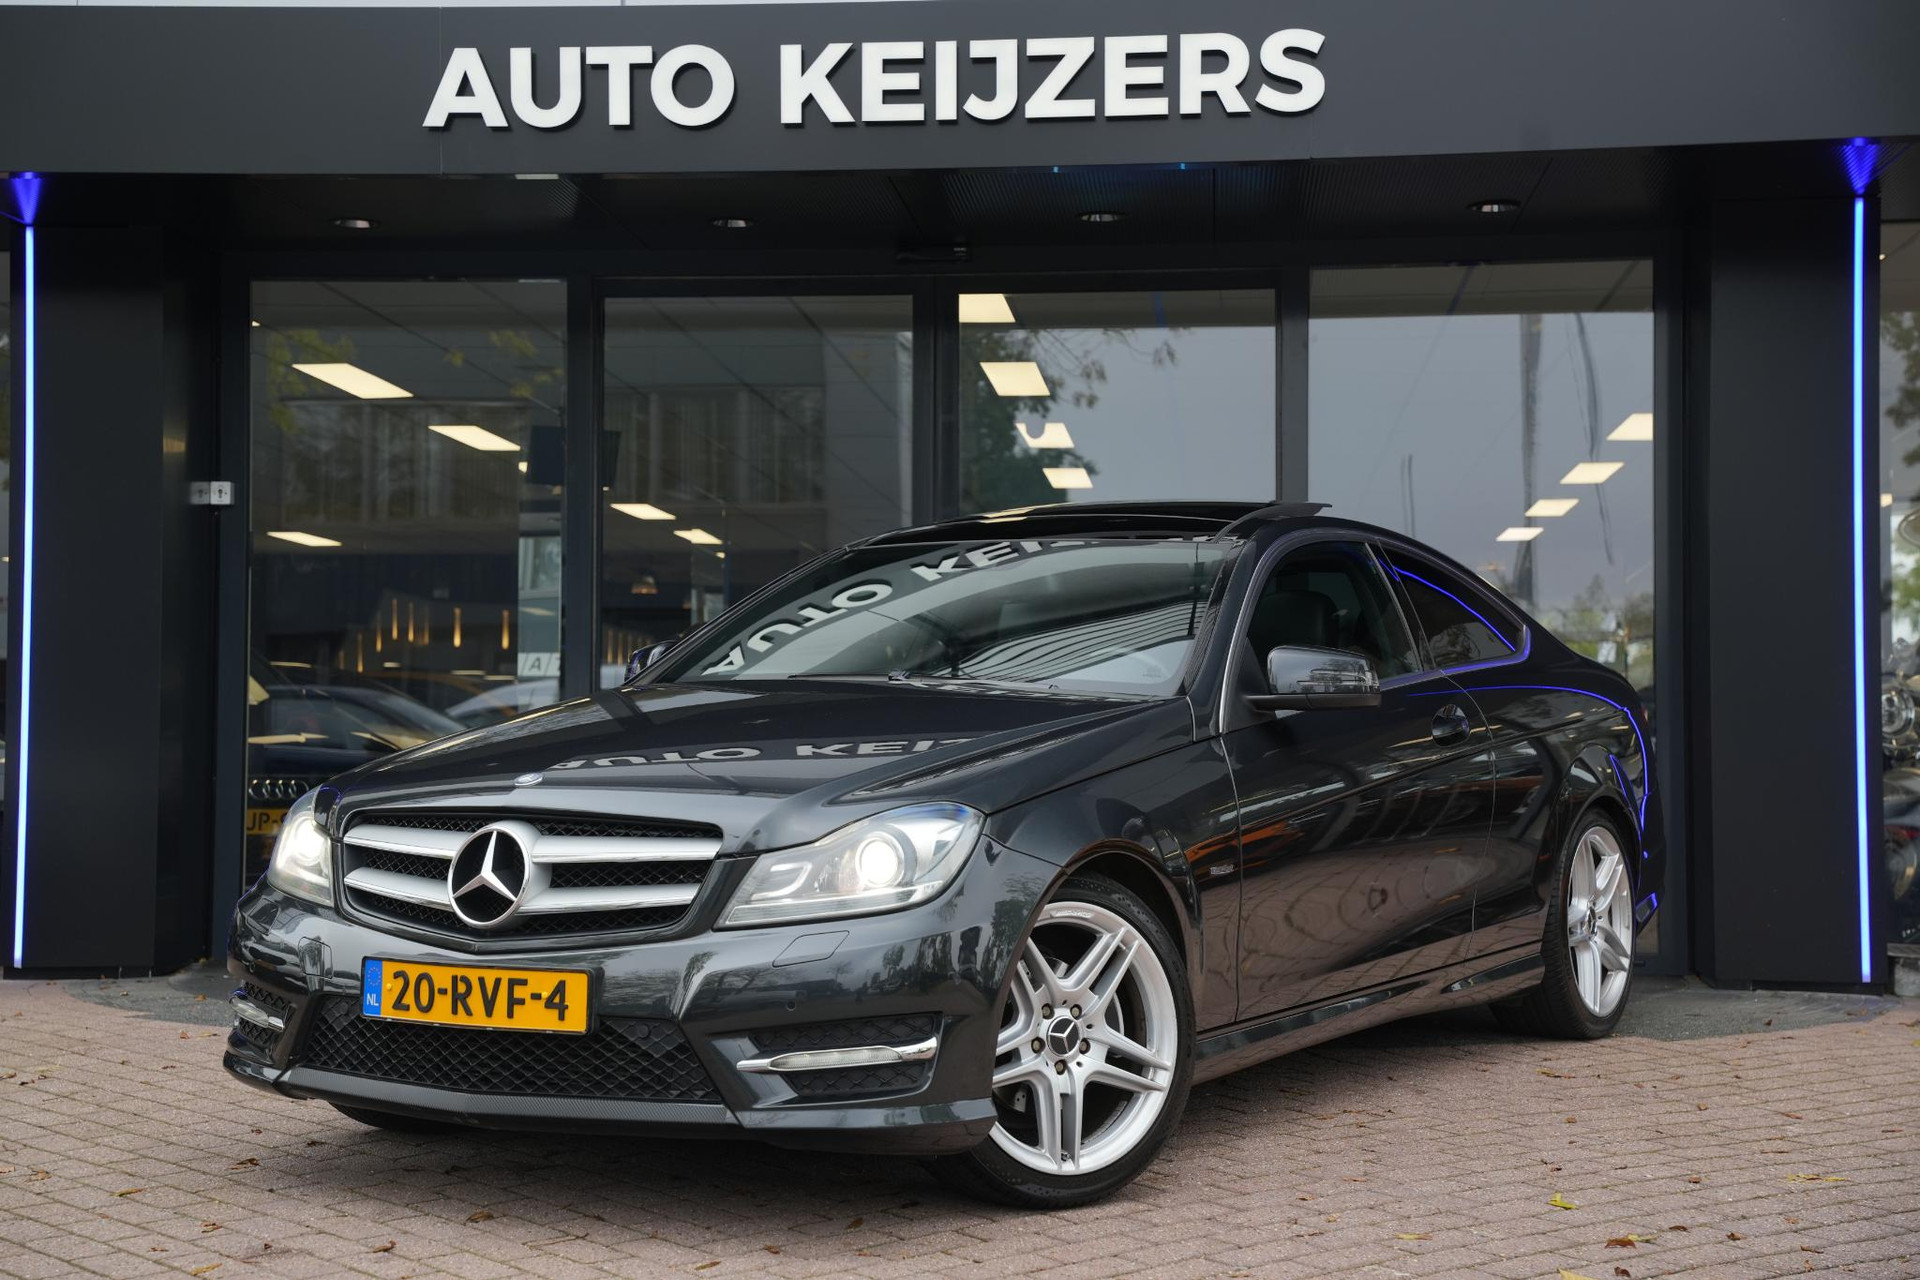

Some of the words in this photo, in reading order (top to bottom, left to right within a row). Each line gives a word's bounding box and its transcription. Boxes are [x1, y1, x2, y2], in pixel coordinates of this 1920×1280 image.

[423, 44, 735, 128] AUTO
[780, 28, 1326, 126] KEIJZERS
[246, 811, 287, 832] JP-
[366, 992, 379, 1006] NL
[391, 969, 570, 1022] 20-RVF-4
